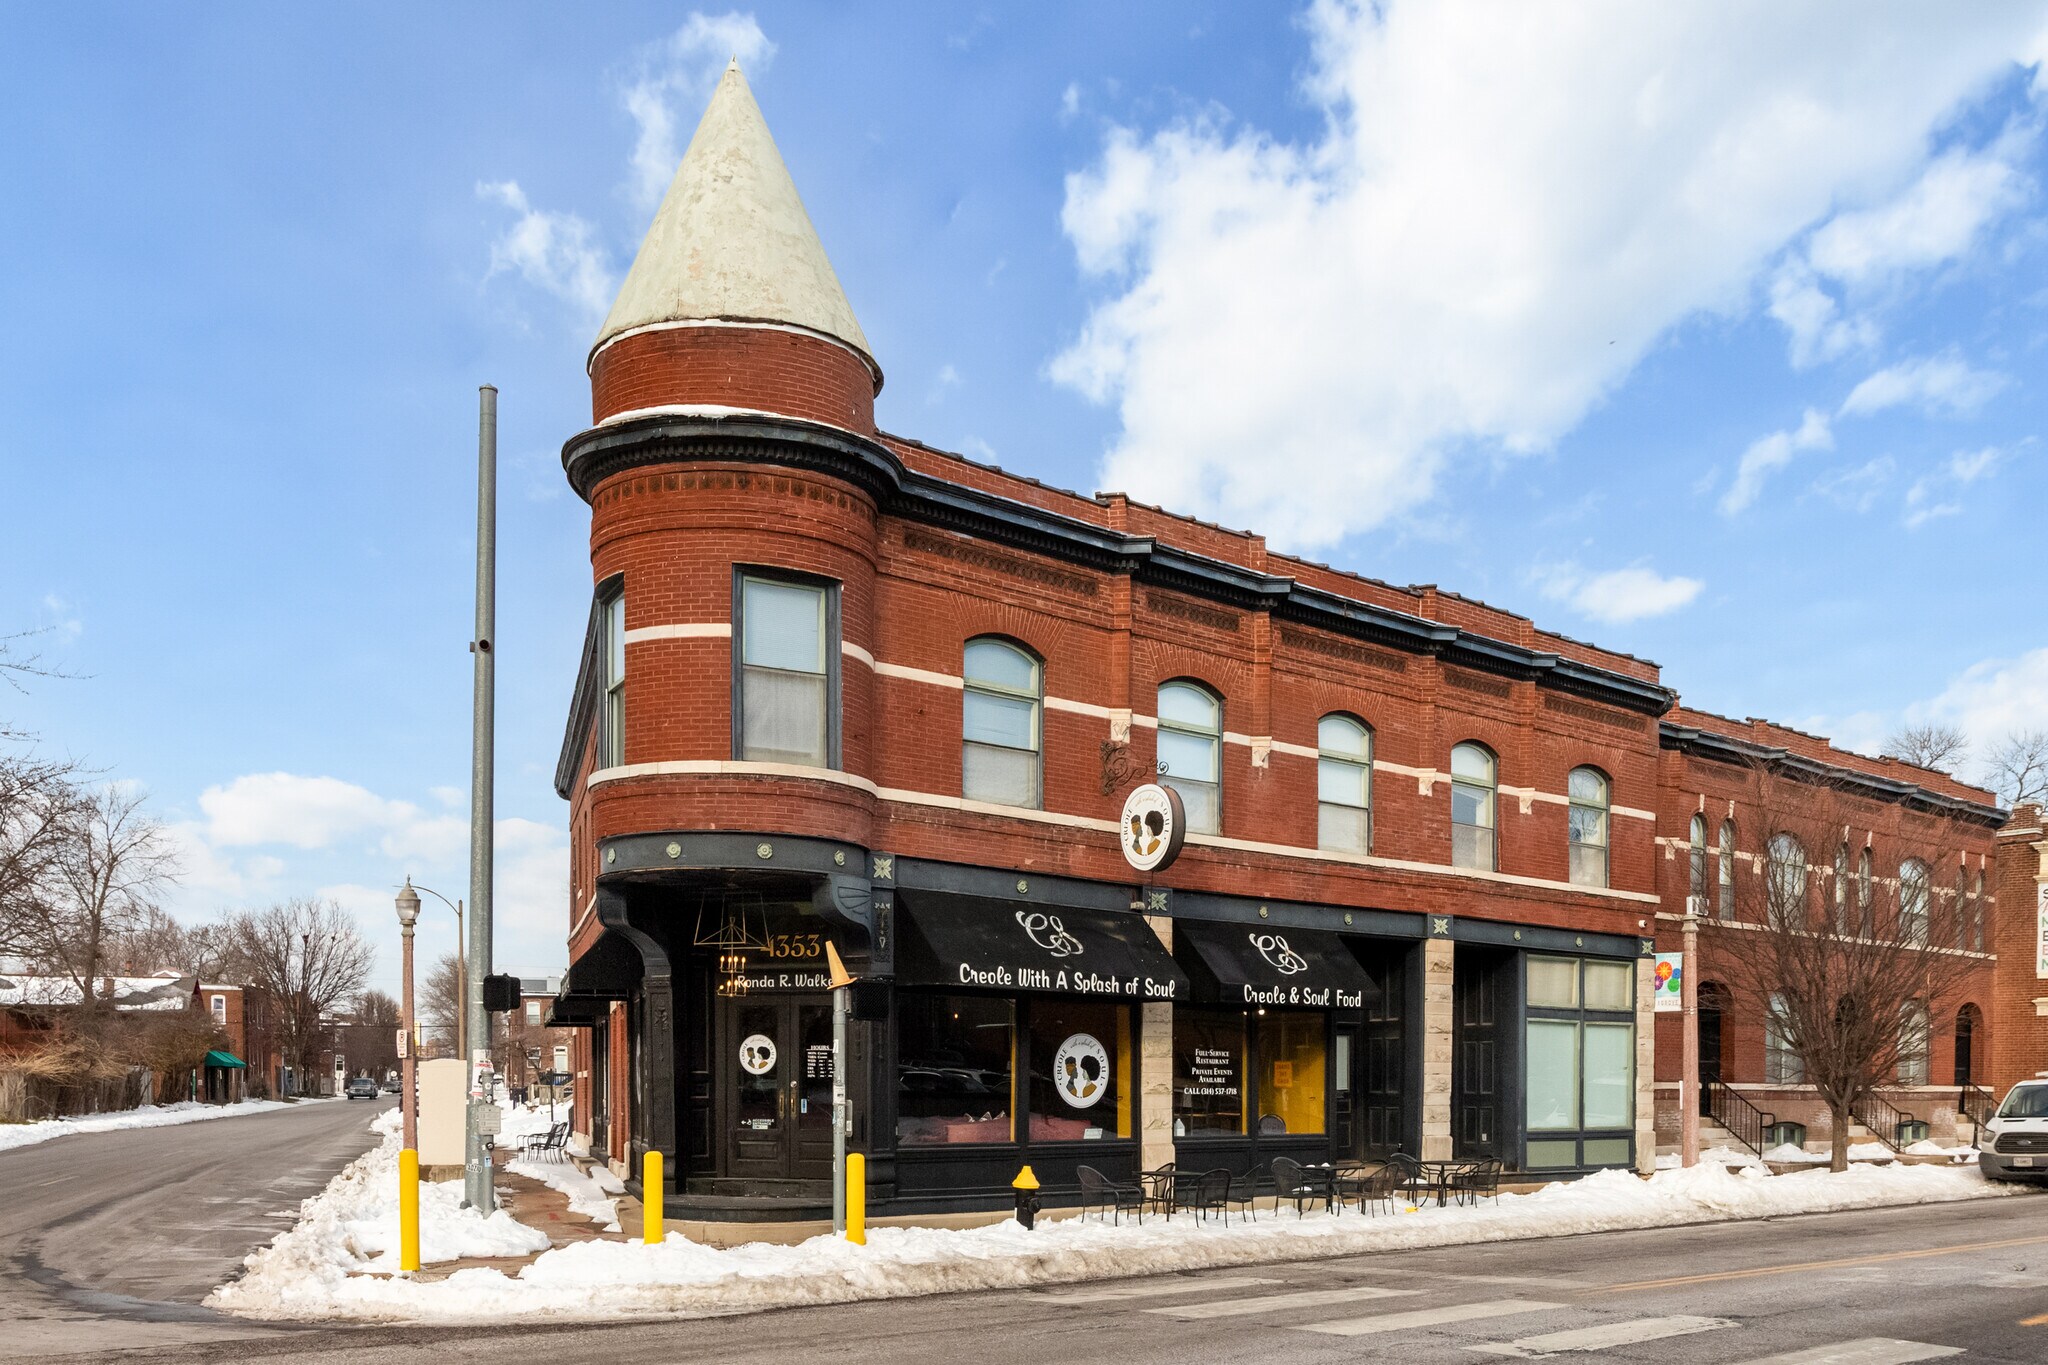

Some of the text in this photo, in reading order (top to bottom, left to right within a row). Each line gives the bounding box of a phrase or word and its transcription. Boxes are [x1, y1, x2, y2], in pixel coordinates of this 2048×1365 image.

[760, 934, 821, 957] 1353
[737, 974, 833, 988] Ronda R. Walke
[959, 963, 1176, 998] Creole With A Splash of Soul
[1244, 984, 1362, 1007] Creole & Soul Food
[1057, 1047, 1069, 1081] CREOLE
[1096, 1048, 1107, 1080] SOUL
[1183, 1087, 1201, 1095] CALL
[1200, 1087, 1214, 1096] (314)
